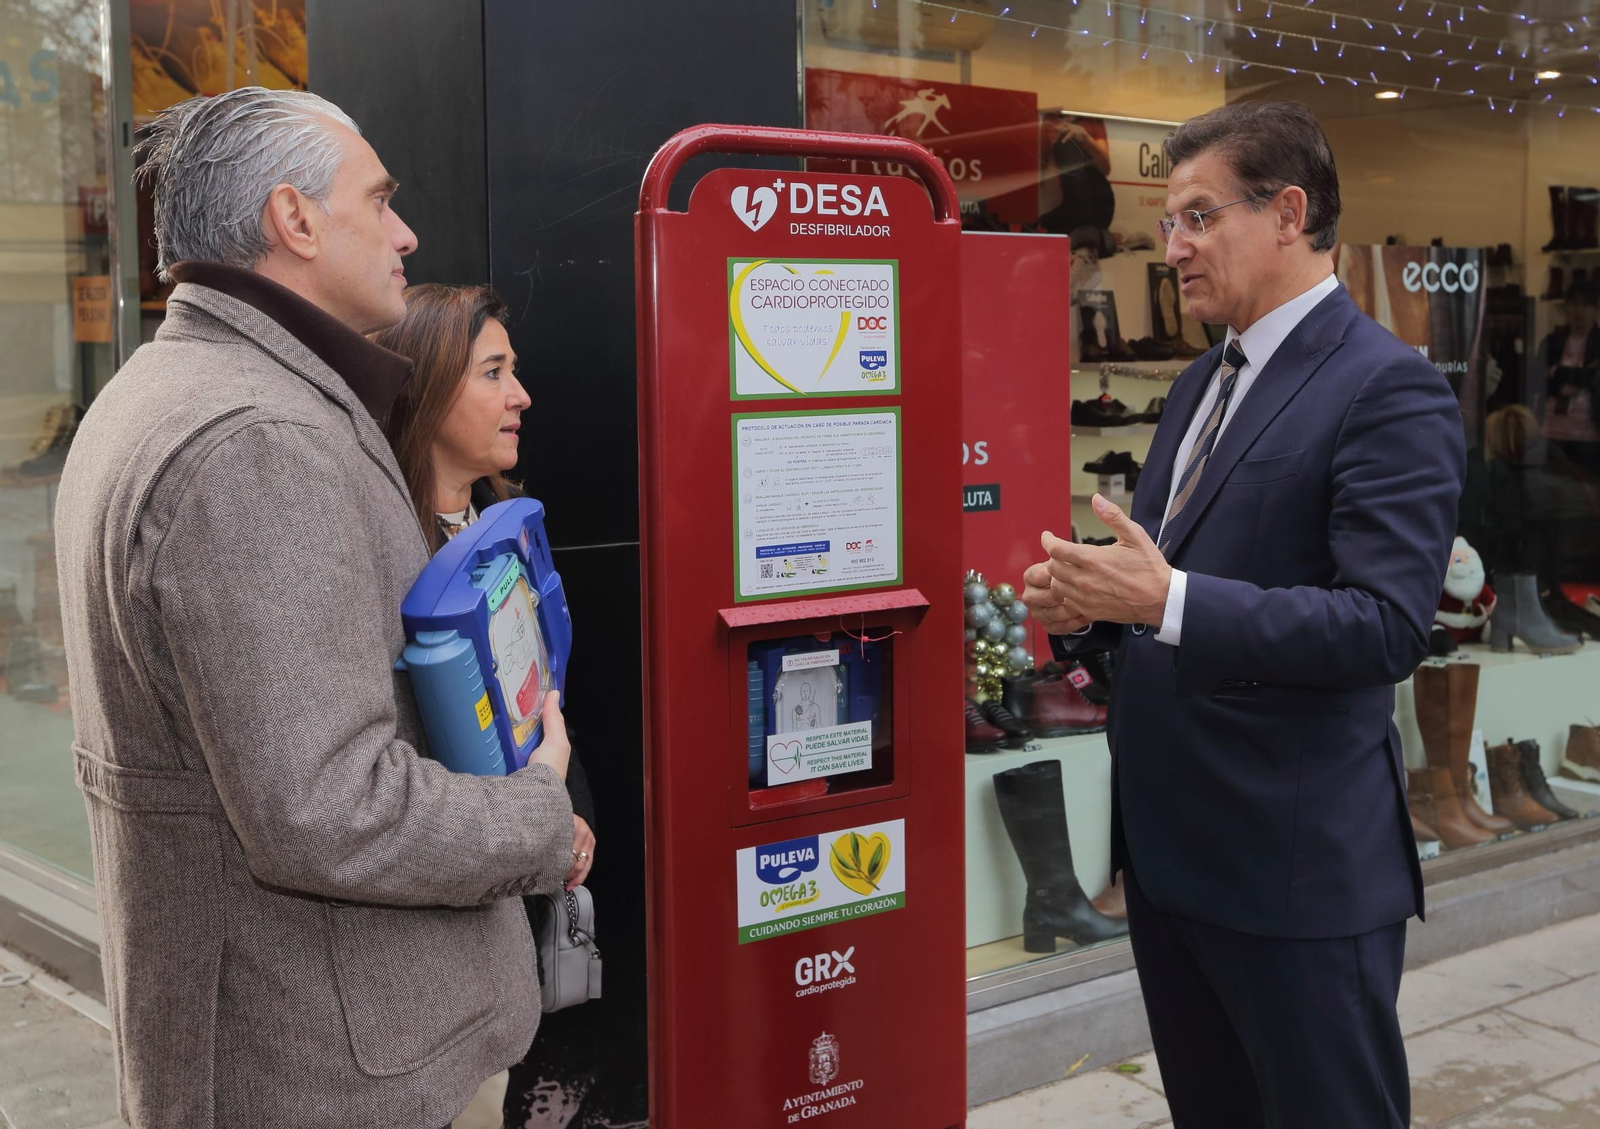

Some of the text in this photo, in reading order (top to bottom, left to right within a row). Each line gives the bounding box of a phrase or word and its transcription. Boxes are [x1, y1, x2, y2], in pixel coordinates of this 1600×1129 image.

[790, 183, 889, 217] DESA
[790, 223, 890, 237] DESFIBRILADOR
[1402, 261, 1479, 293] ecco
[751, 279, 889, 291] ESPACIO CONECTADO
[751, 295, 889, 309] CARDIOPROTEGIDO
[763, 324, 833, 336] Todos podemos
[857, 316, 887, 330] DOC
[1435, 359, 1468, 373] DURÍAS
[861, 371, 882, 379] OMEGA
[846, 541, 861, 550] DOC
[500, 575, 513, 595] PULL
[806, 734, 829, 742] RESPETA
[843, 728, 868, 737] MATERIAL
[806, 735, 869, 750] PUEDE SALVAR VIDAS
[807, 757, 831, 766] RESPECT
[843, 751, 868, 760] MATERIAL
[817, 764, 831, 772] CAN
[831, 762, 848, 770] SAVE
[849, 759, 864, 767] LIVES
[760, 847, 815, 869] PULEVA
[760, 880, 817, 907] OMEGA 3
[750, 897, 897, 938] CUIDANDO SIEMPRE TU CORAZÓN
[795, 946, 855, 986] GRX
[801, 1095, 856, 1119] GRANADA
